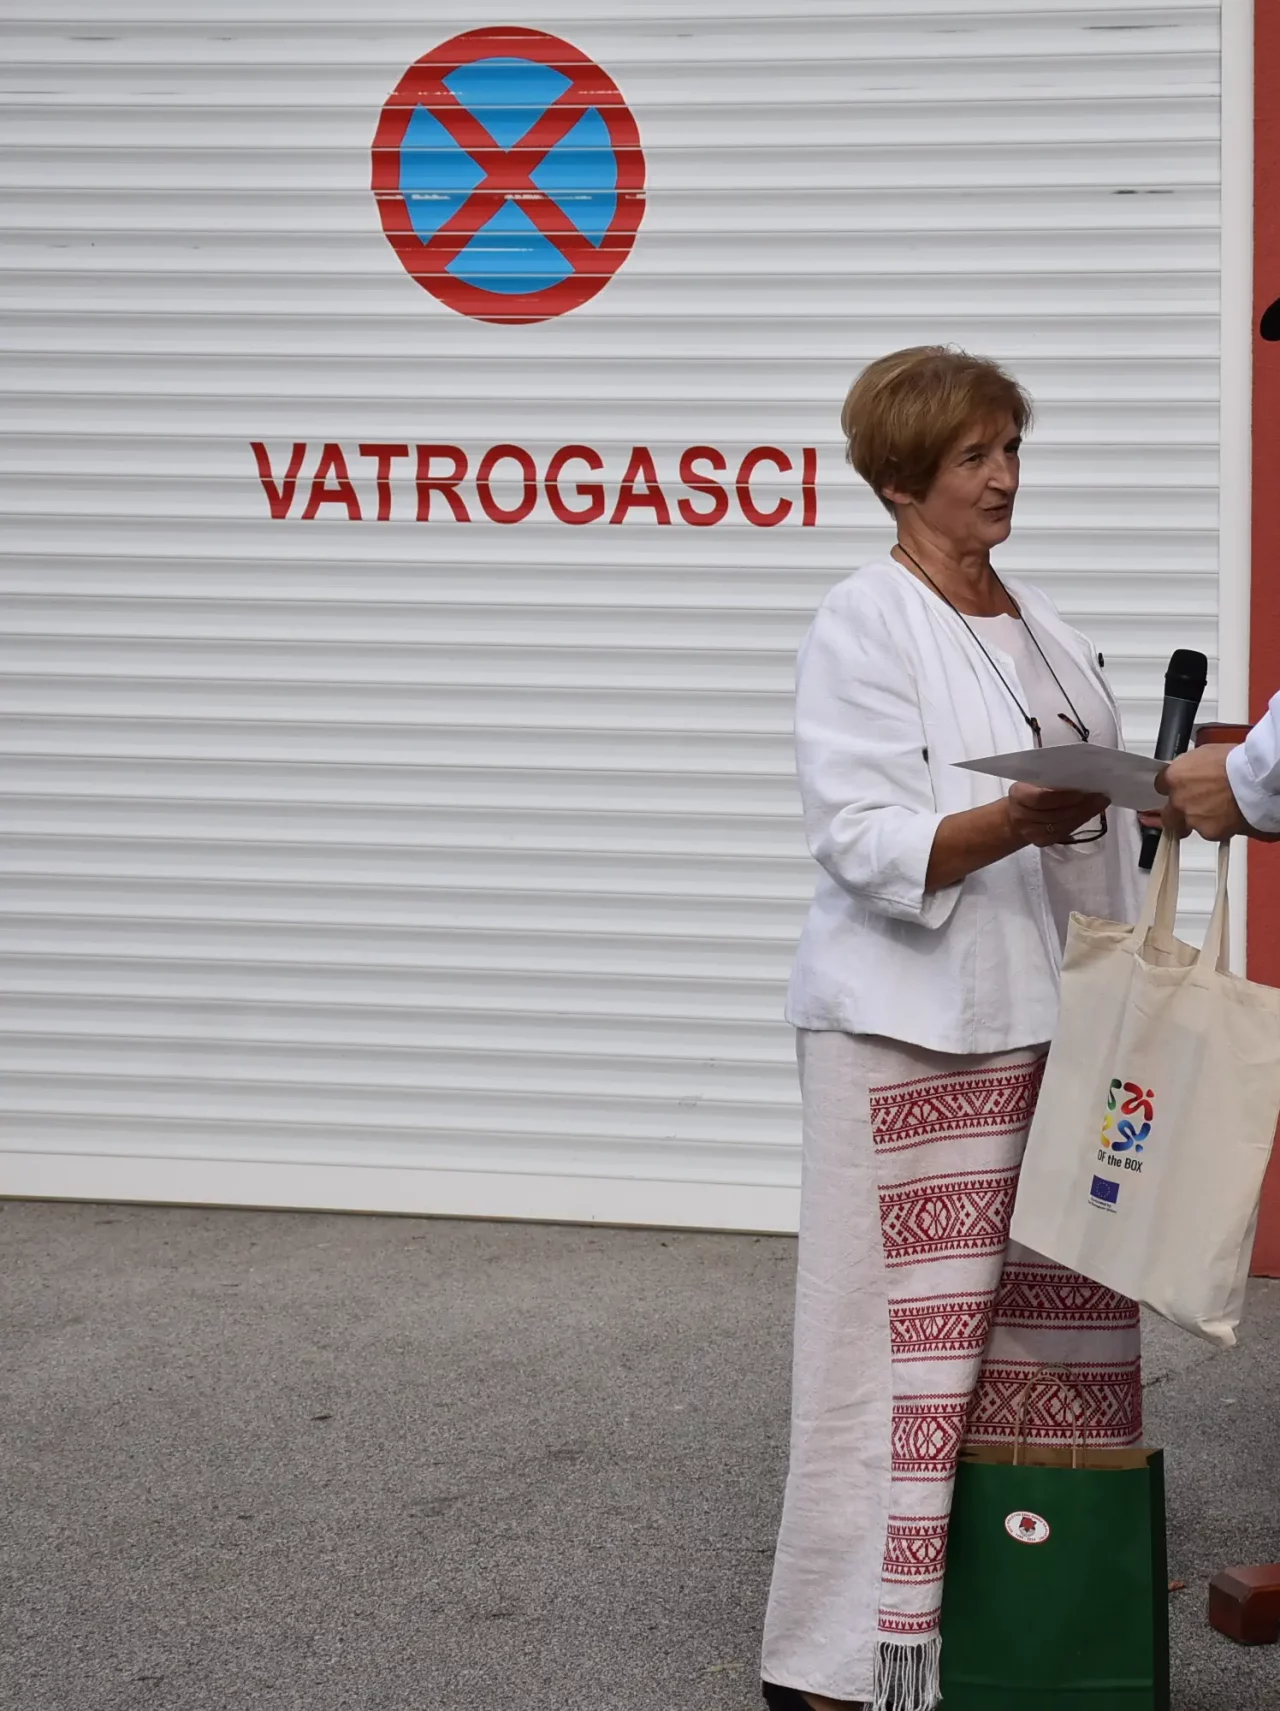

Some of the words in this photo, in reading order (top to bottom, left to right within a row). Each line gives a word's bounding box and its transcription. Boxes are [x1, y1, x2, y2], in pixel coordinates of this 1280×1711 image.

[250, 441, 817, 527] VATROGASCI
[1097, 1149, 1107, 1163] OF
[1107, 1154, 1122, 1168] the
[1124, 1157, 1143, 1173] BOX
